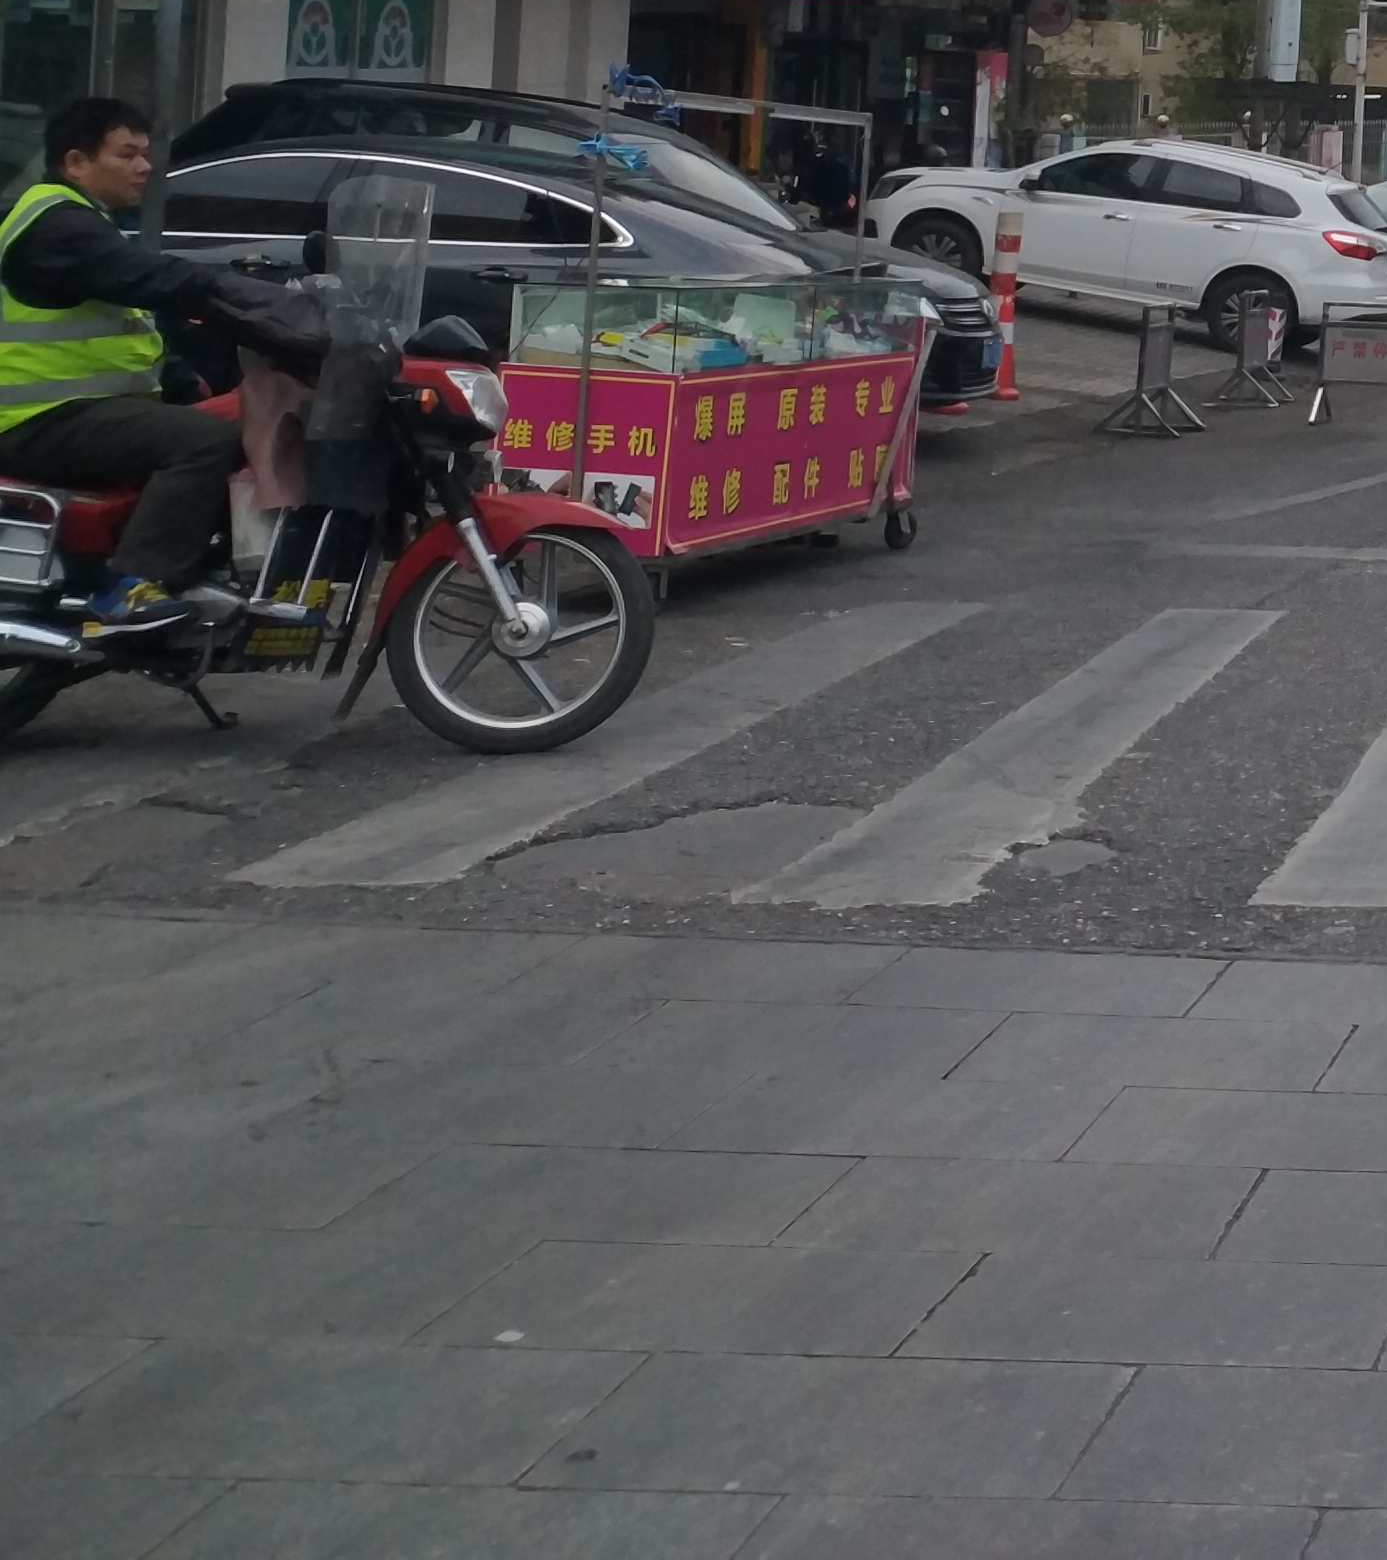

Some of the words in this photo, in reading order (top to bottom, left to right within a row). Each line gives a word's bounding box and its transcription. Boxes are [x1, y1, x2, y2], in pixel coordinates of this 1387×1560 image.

[503, 417, 656, 458] 维修手机
[693, 391, 747, 443] 爆屏
[777, 385, 826, 431] 原装
[854, 376, 895, 419] 专业
[687, 470, 741, 521] 维修
[772, 458, 820, 505] 配件
